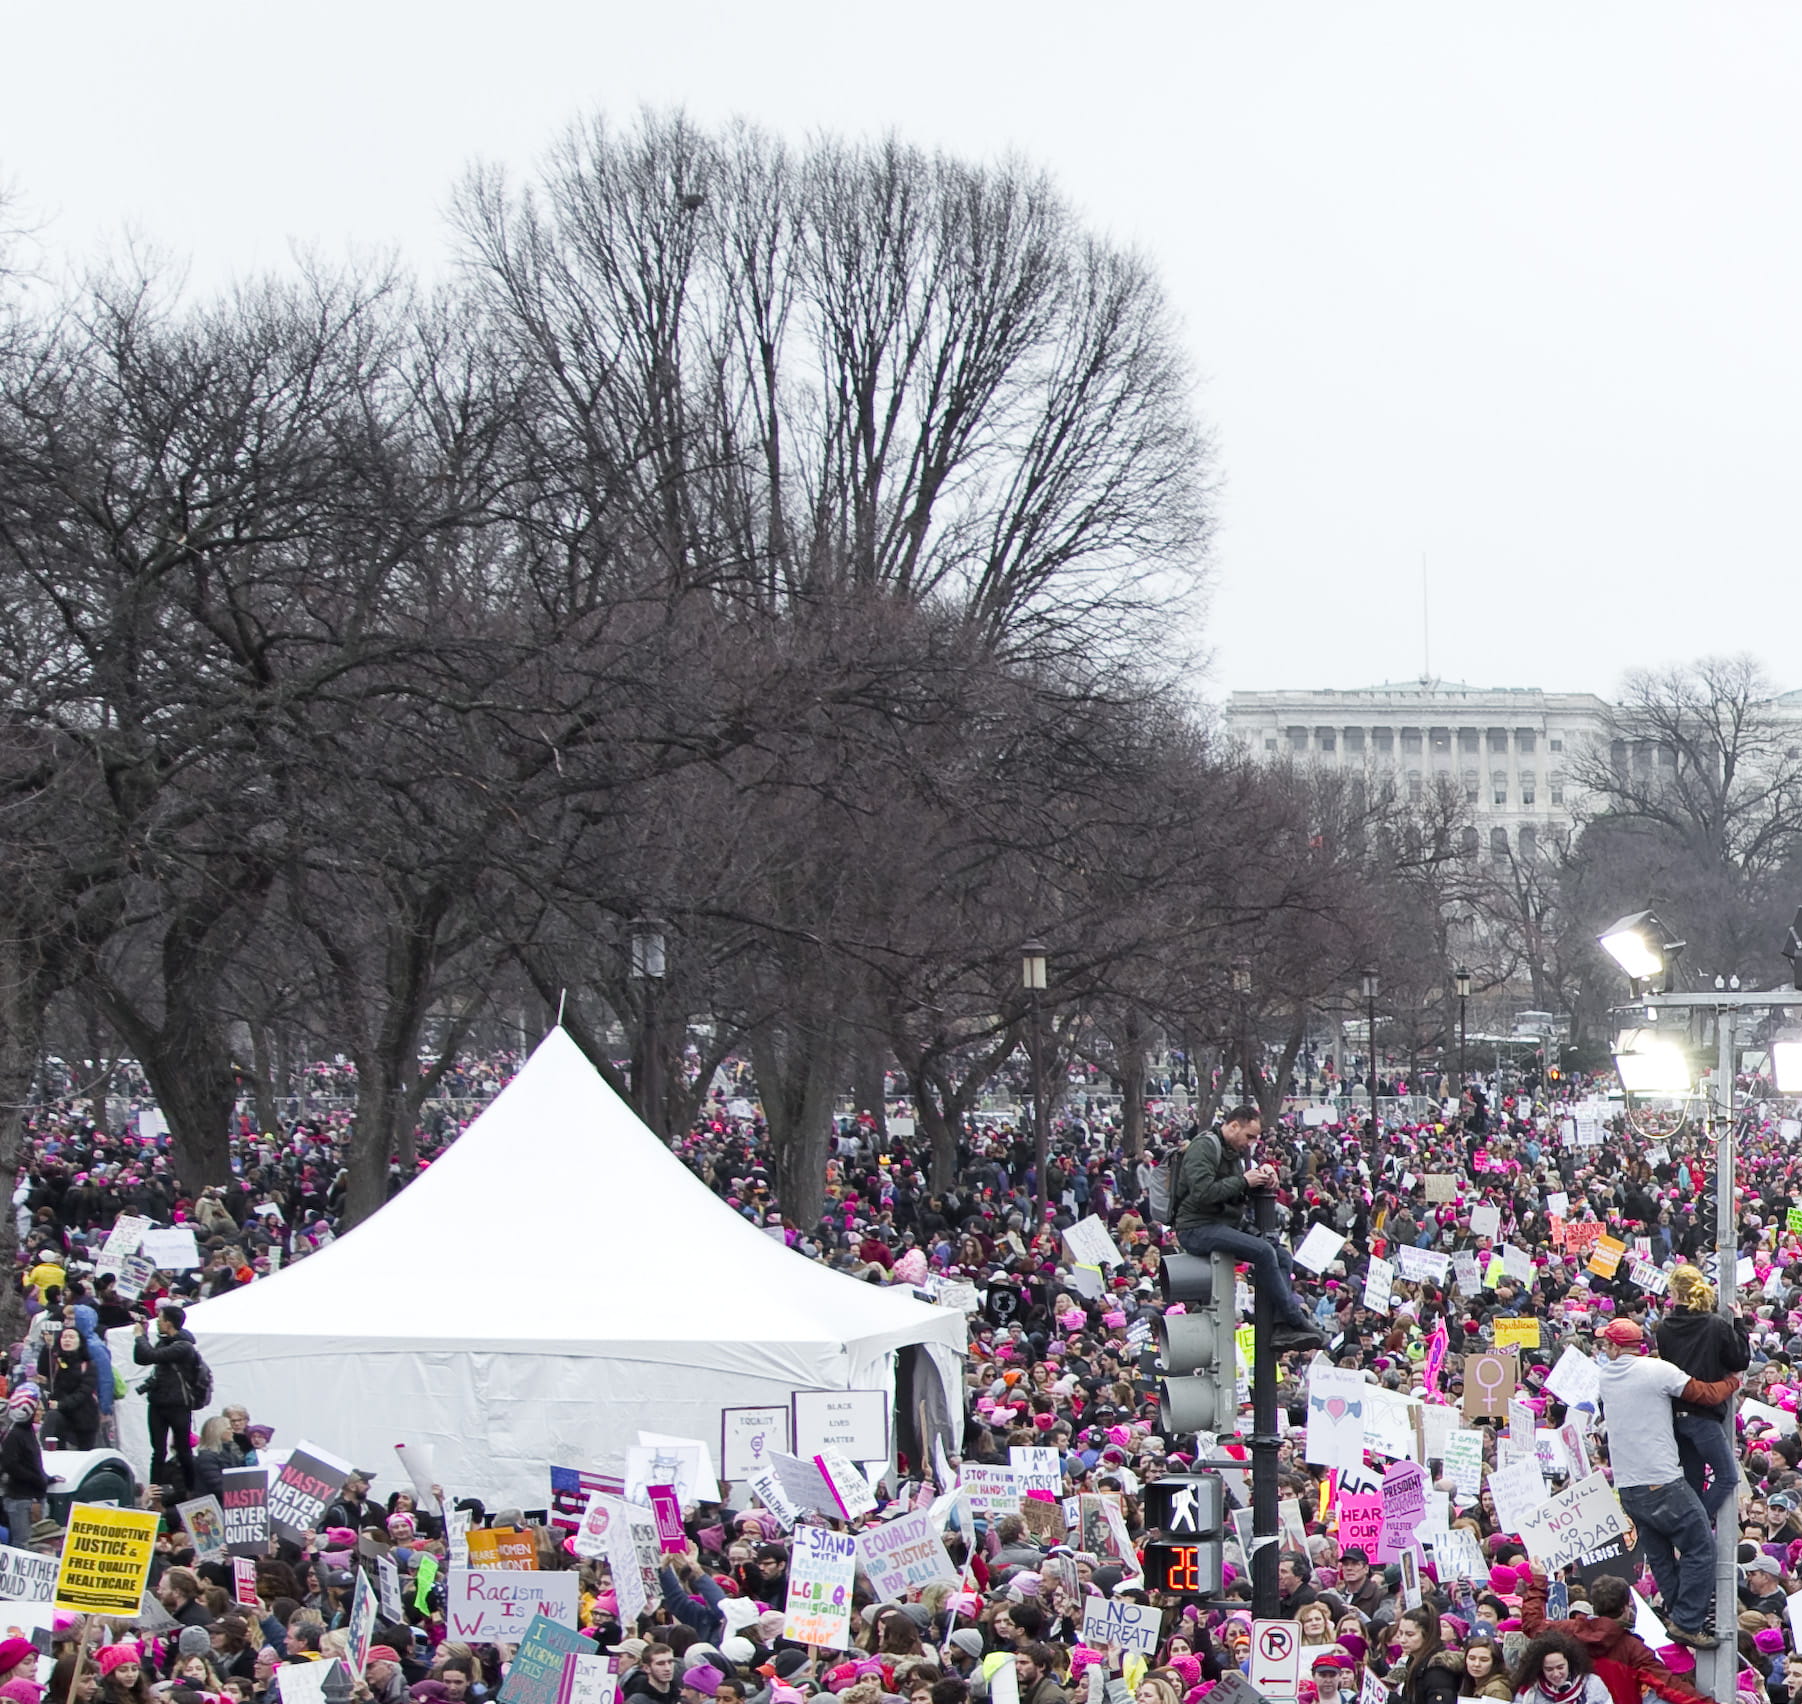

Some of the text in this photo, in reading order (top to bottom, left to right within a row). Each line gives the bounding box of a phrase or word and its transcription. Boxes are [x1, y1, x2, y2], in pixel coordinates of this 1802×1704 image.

[224, 1489, 265, 1508] NASTY
[224, 1506, 267, 1525] NEVER
[72, 1522, 150, 1541] REPRODUCTIVE
[225, 1524, 268, 1544] QUITS.
[74, 1538, 137, 1557] JUSTICE &
[68, 1558, 142, 1575] FREE QUALITY
[66, 1573, 137, 1592] HEALTHCARE
[1107, 1601, 1143, 1624] NO
[1085, 1617, 1156, 1650] RETREAT
